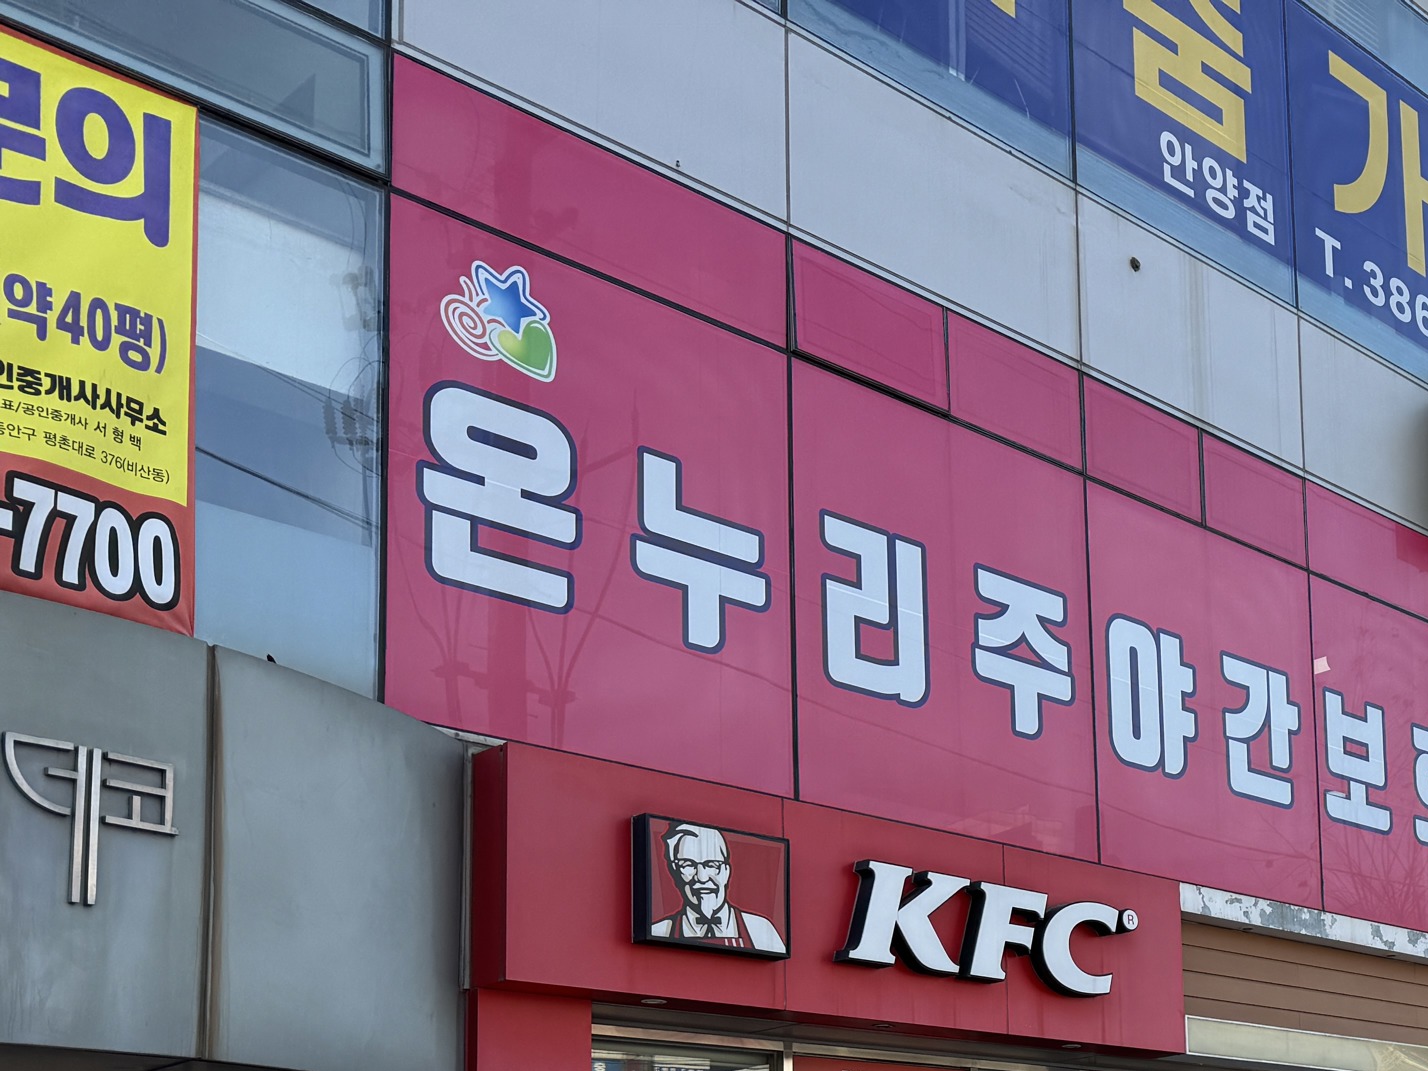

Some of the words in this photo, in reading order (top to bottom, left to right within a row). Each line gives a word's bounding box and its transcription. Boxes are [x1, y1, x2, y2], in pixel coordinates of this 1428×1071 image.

[1159, 130, 1276, 246] 안양점
[3, 273, 167, 374] 약40평)
[43, 431, 96, 459] 평촌대로
[100, 450, 170, 484] 376(비산동)
[842, 859, 1120, 997] KFC
